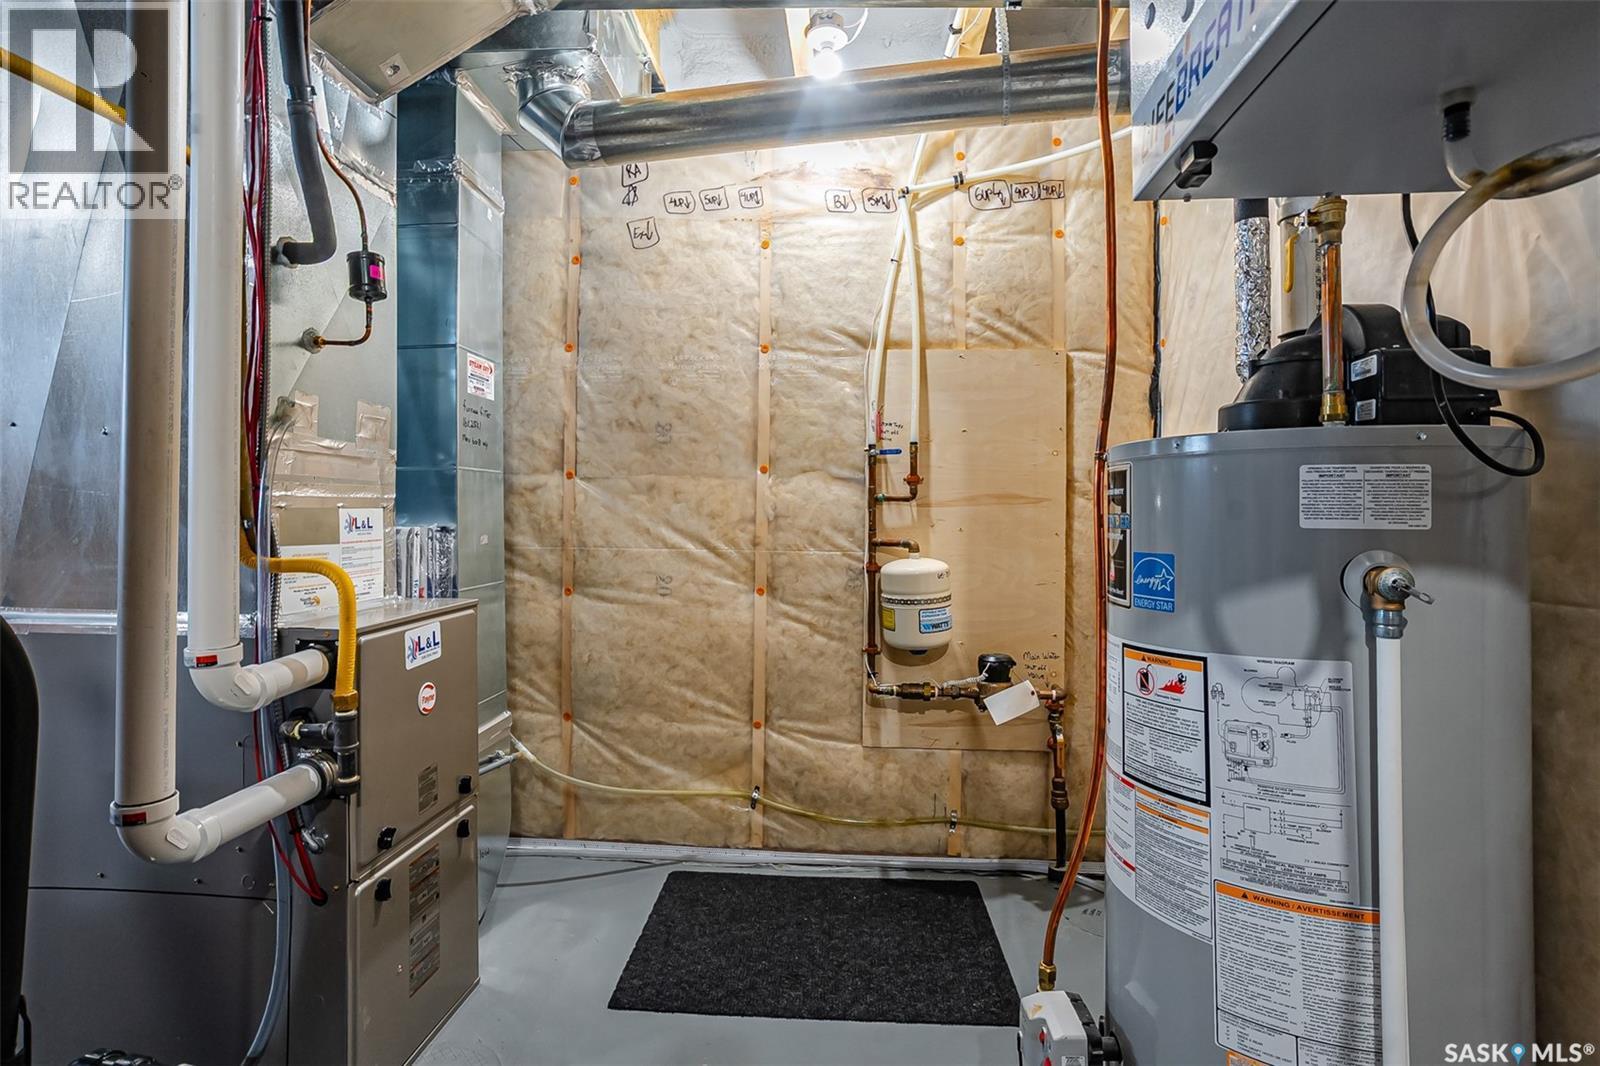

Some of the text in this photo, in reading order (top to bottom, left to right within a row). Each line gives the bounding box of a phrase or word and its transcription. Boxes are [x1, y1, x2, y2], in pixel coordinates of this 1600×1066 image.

[1135, 598, 1174, 611] ENERGY STAR
[1147, 656, 1171, 666] WARNING
[1252, 895, 1290, 909] WARNING
[1296, 904, 1365, 920] AVERTISSEMENT
